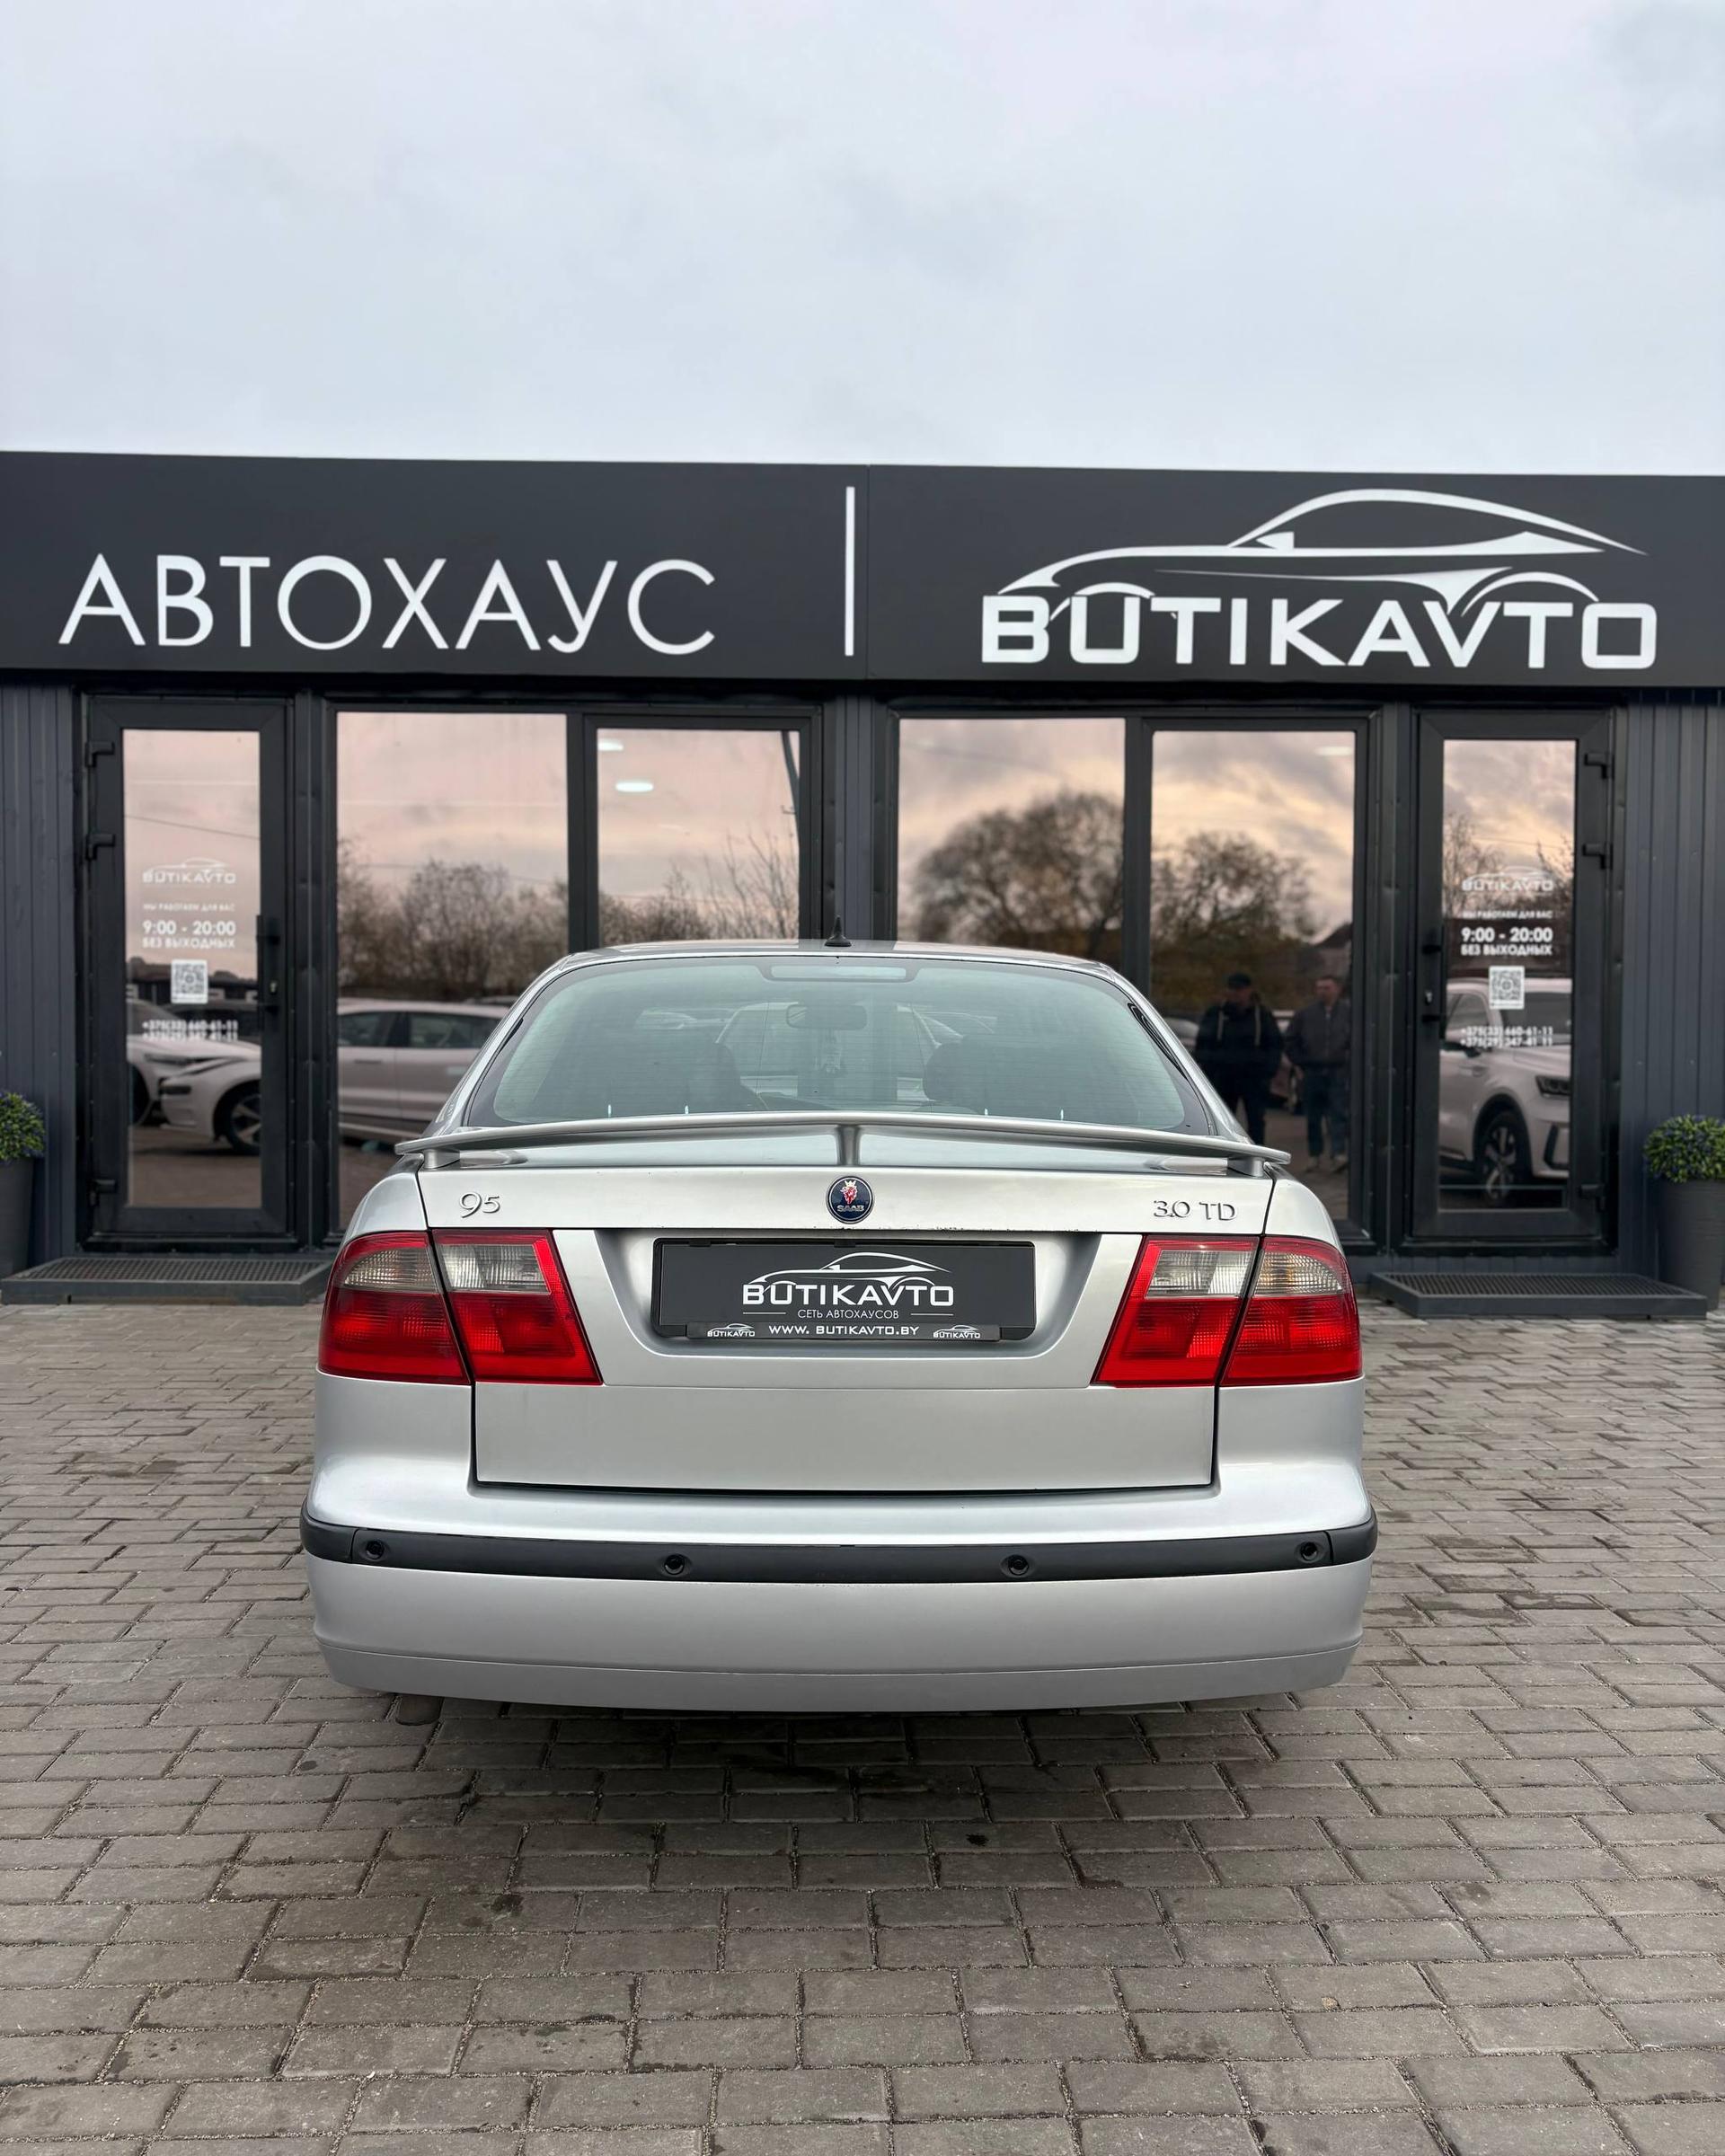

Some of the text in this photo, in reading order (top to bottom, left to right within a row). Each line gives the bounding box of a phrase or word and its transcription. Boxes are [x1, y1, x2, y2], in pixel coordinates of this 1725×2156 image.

[58, 552, 715, 655] АВТОХАУС
[981, 595, 1658, 669] BUTIKAVTO
[142, 871, 236, 884] BUTIKAVTO
[1462, 879, 1554, 892] BUTIKAVTO
[142, 920, 177, 935] 9:00
[192, 920, 236, 935] 20:00
[1461, 927, 1495, 942] 9:00
[1509, 927, 1553, 942] 20:00
[142, 937, 235, 950] БЕЗ ВЫХОДНЫХ
[1461, 944, 1552, 956] БЕЗ ВЫХОДНЫХ
[836, 1205, 864, 1213] SAAB
[1199, 1201, 1237, 1221] TD
[742, 1283, 954, 1306] BUTIKAVTO
[797, 1309, 899, 1320] СЕТЬ АВТОХАУСОВ
[706, 1330, 756, 1338] BUTIKAVTO
[816, 1325, 919, 1336] BUTIKAVTO.BY
[933, 1331, 981, 1339] BUTIKAVTO
